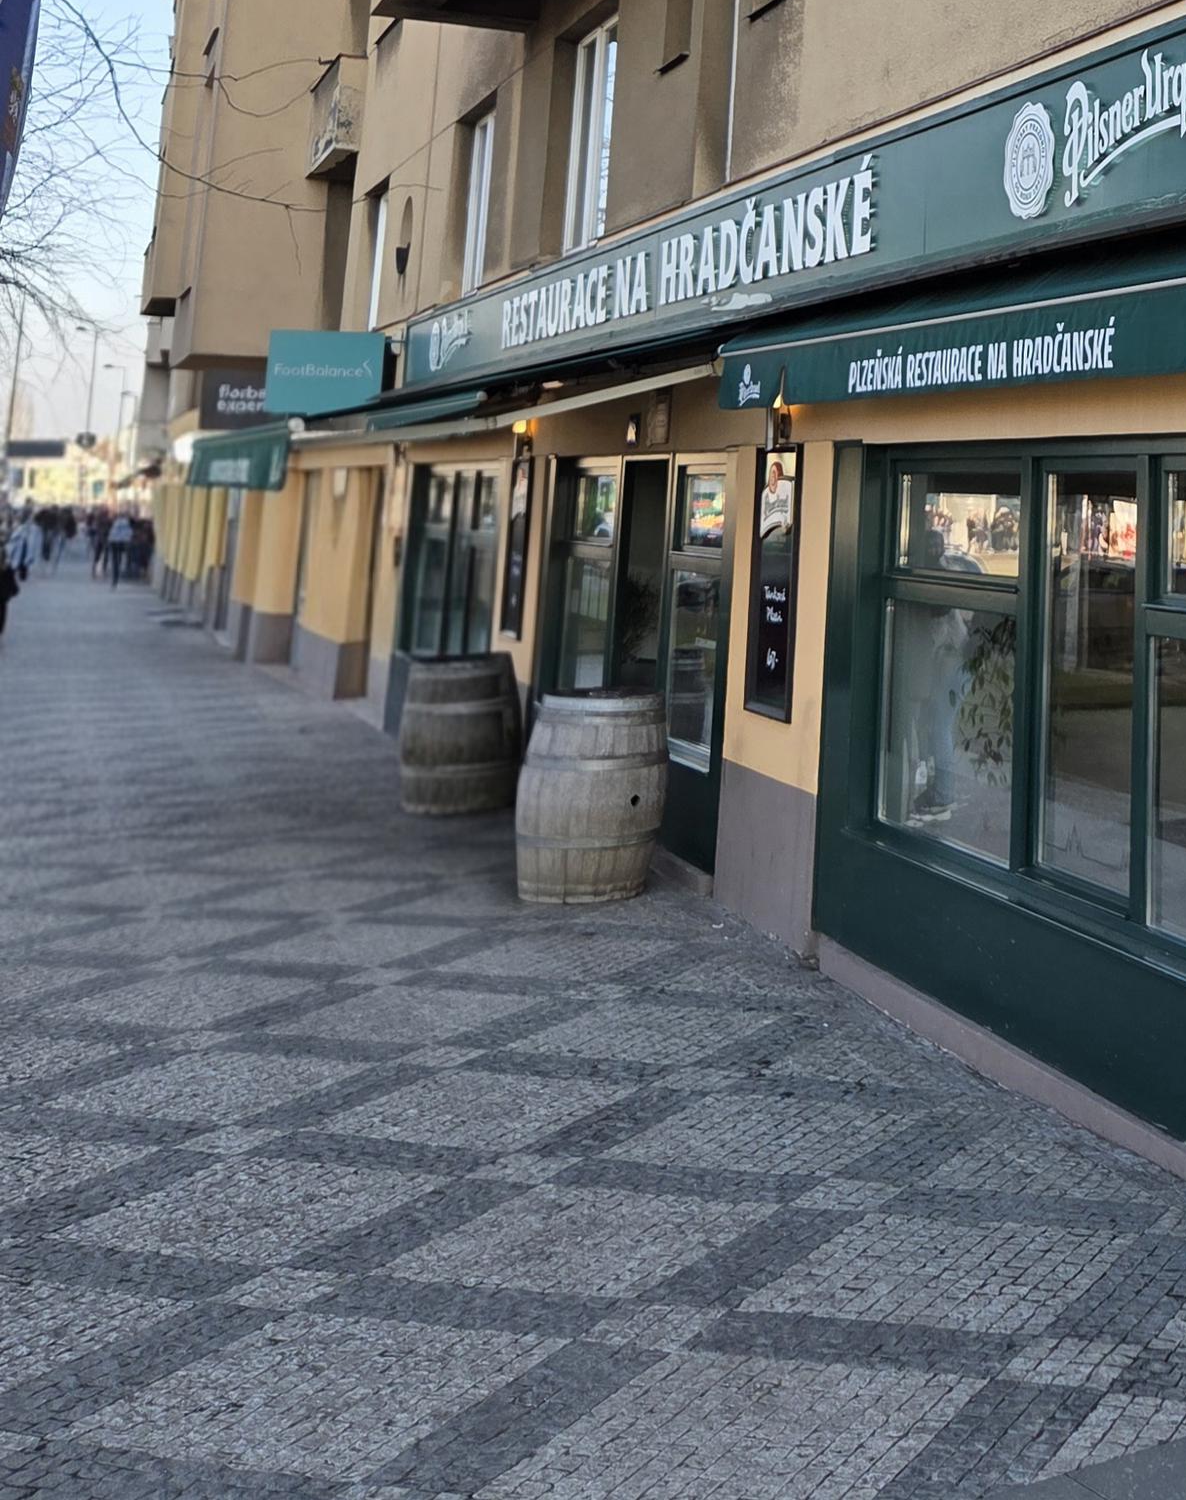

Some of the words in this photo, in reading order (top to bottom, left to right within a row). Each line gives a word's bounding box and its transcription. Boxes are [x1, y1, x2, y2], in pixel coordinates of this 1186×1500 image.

[1062, 80, 1146, 208] Pilsner
[501, 264, 608, 349] RESTAURACE
[613, 252, 650, 319] NA
[660, 154, 875, 306] HRADČANSKÉ
[274, 363, 364, 378] FootBalance
[848, 345, 903, 393] PLZEŇSKÁ
[906, 344, 984, 388] RESTAURACE
[987, 346, 1008, 379] NA
[1012, 316, 1116, 377] HRADČANSKÉ
[217, 400, 265, 414] exper
